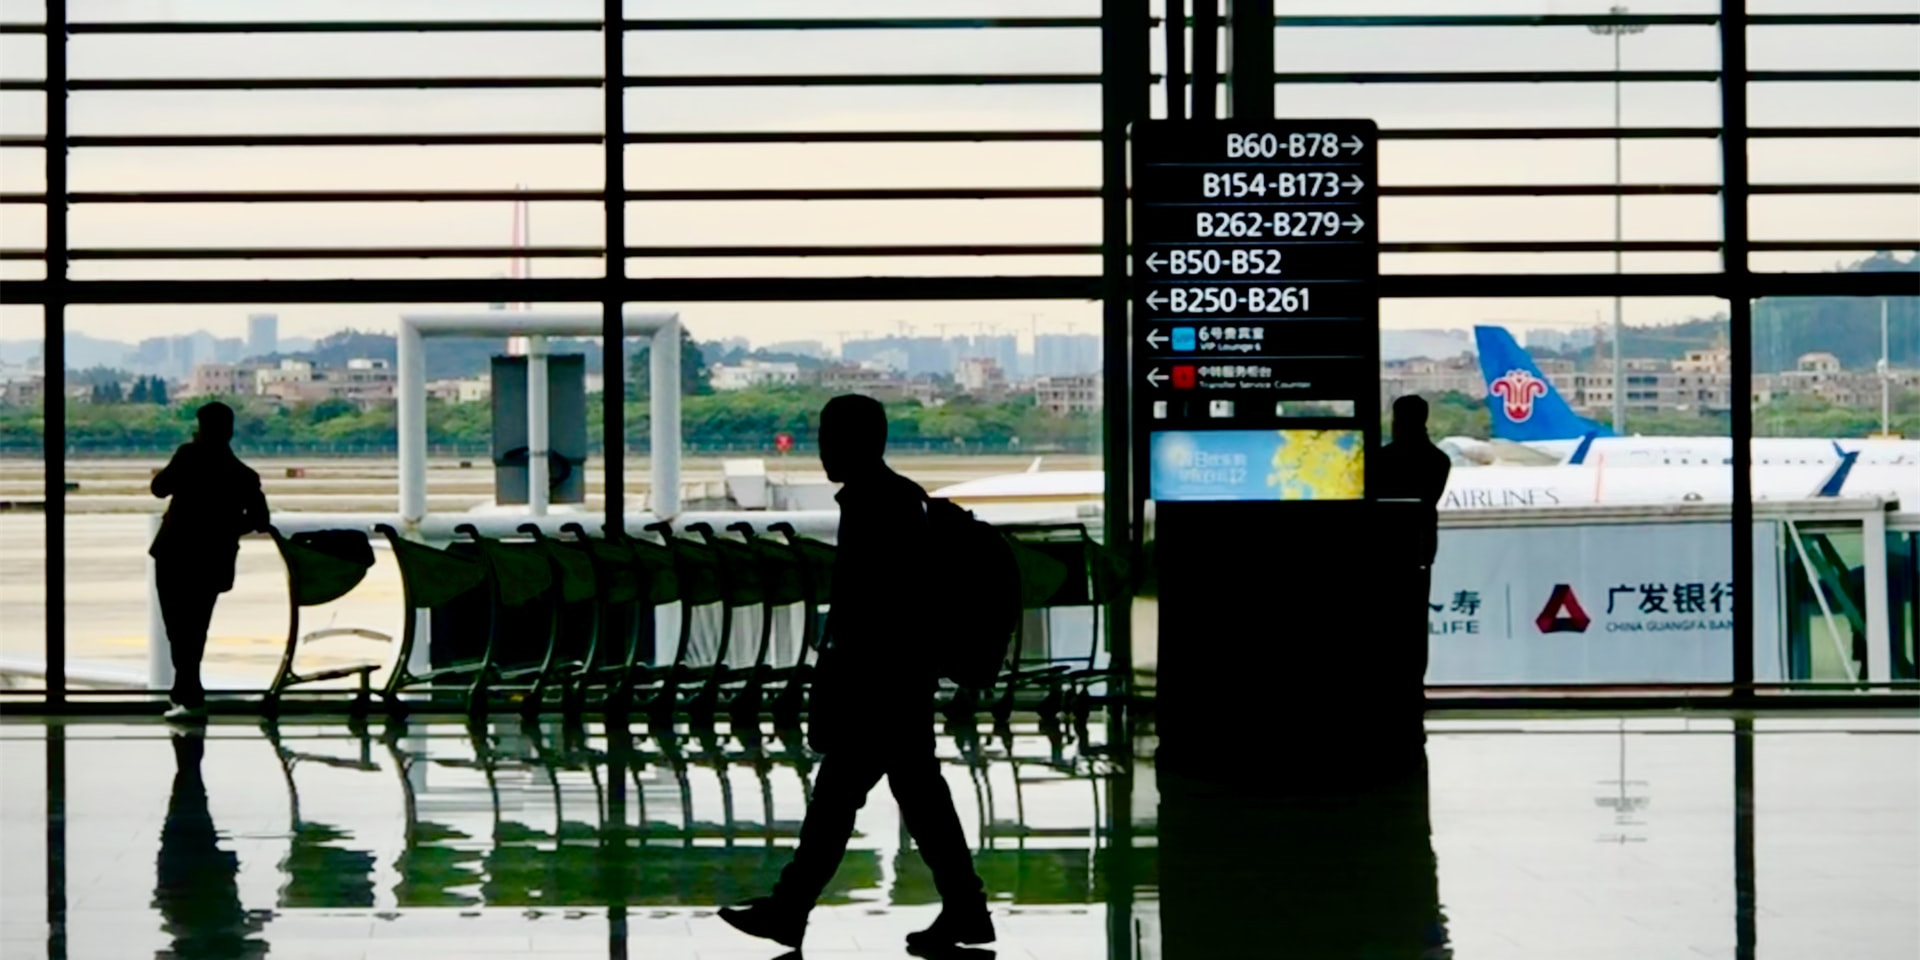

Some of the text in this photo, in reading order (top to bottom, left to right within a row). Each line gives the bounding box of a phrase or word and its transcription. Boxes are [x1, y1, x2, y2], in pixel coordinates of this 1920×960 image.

[1226, 132, 1339, 158] B60-B78
[1203, 172, 1340, 198] B154-B173
[1196, 211, 1340, 238] B262-B279
[1170, 249, 1282, 275] B50-B52
[1170, 287, 1309, 313] B250-B261
[1198, 326, 1265, 342] 6号贵宾室
[1200, 341, 1262, 353] VIP Lounge 6
[1199, 380, 1312, 390] Transfer Service Counter
[1444, 487, 1560, 509] AIRLINES
[1606, 582, 1734, 615] 广发银行
[1428, 620, 1480, 635] LIFE
[1606, 619, 1734, 633] CHINA GUANGFA BAN
